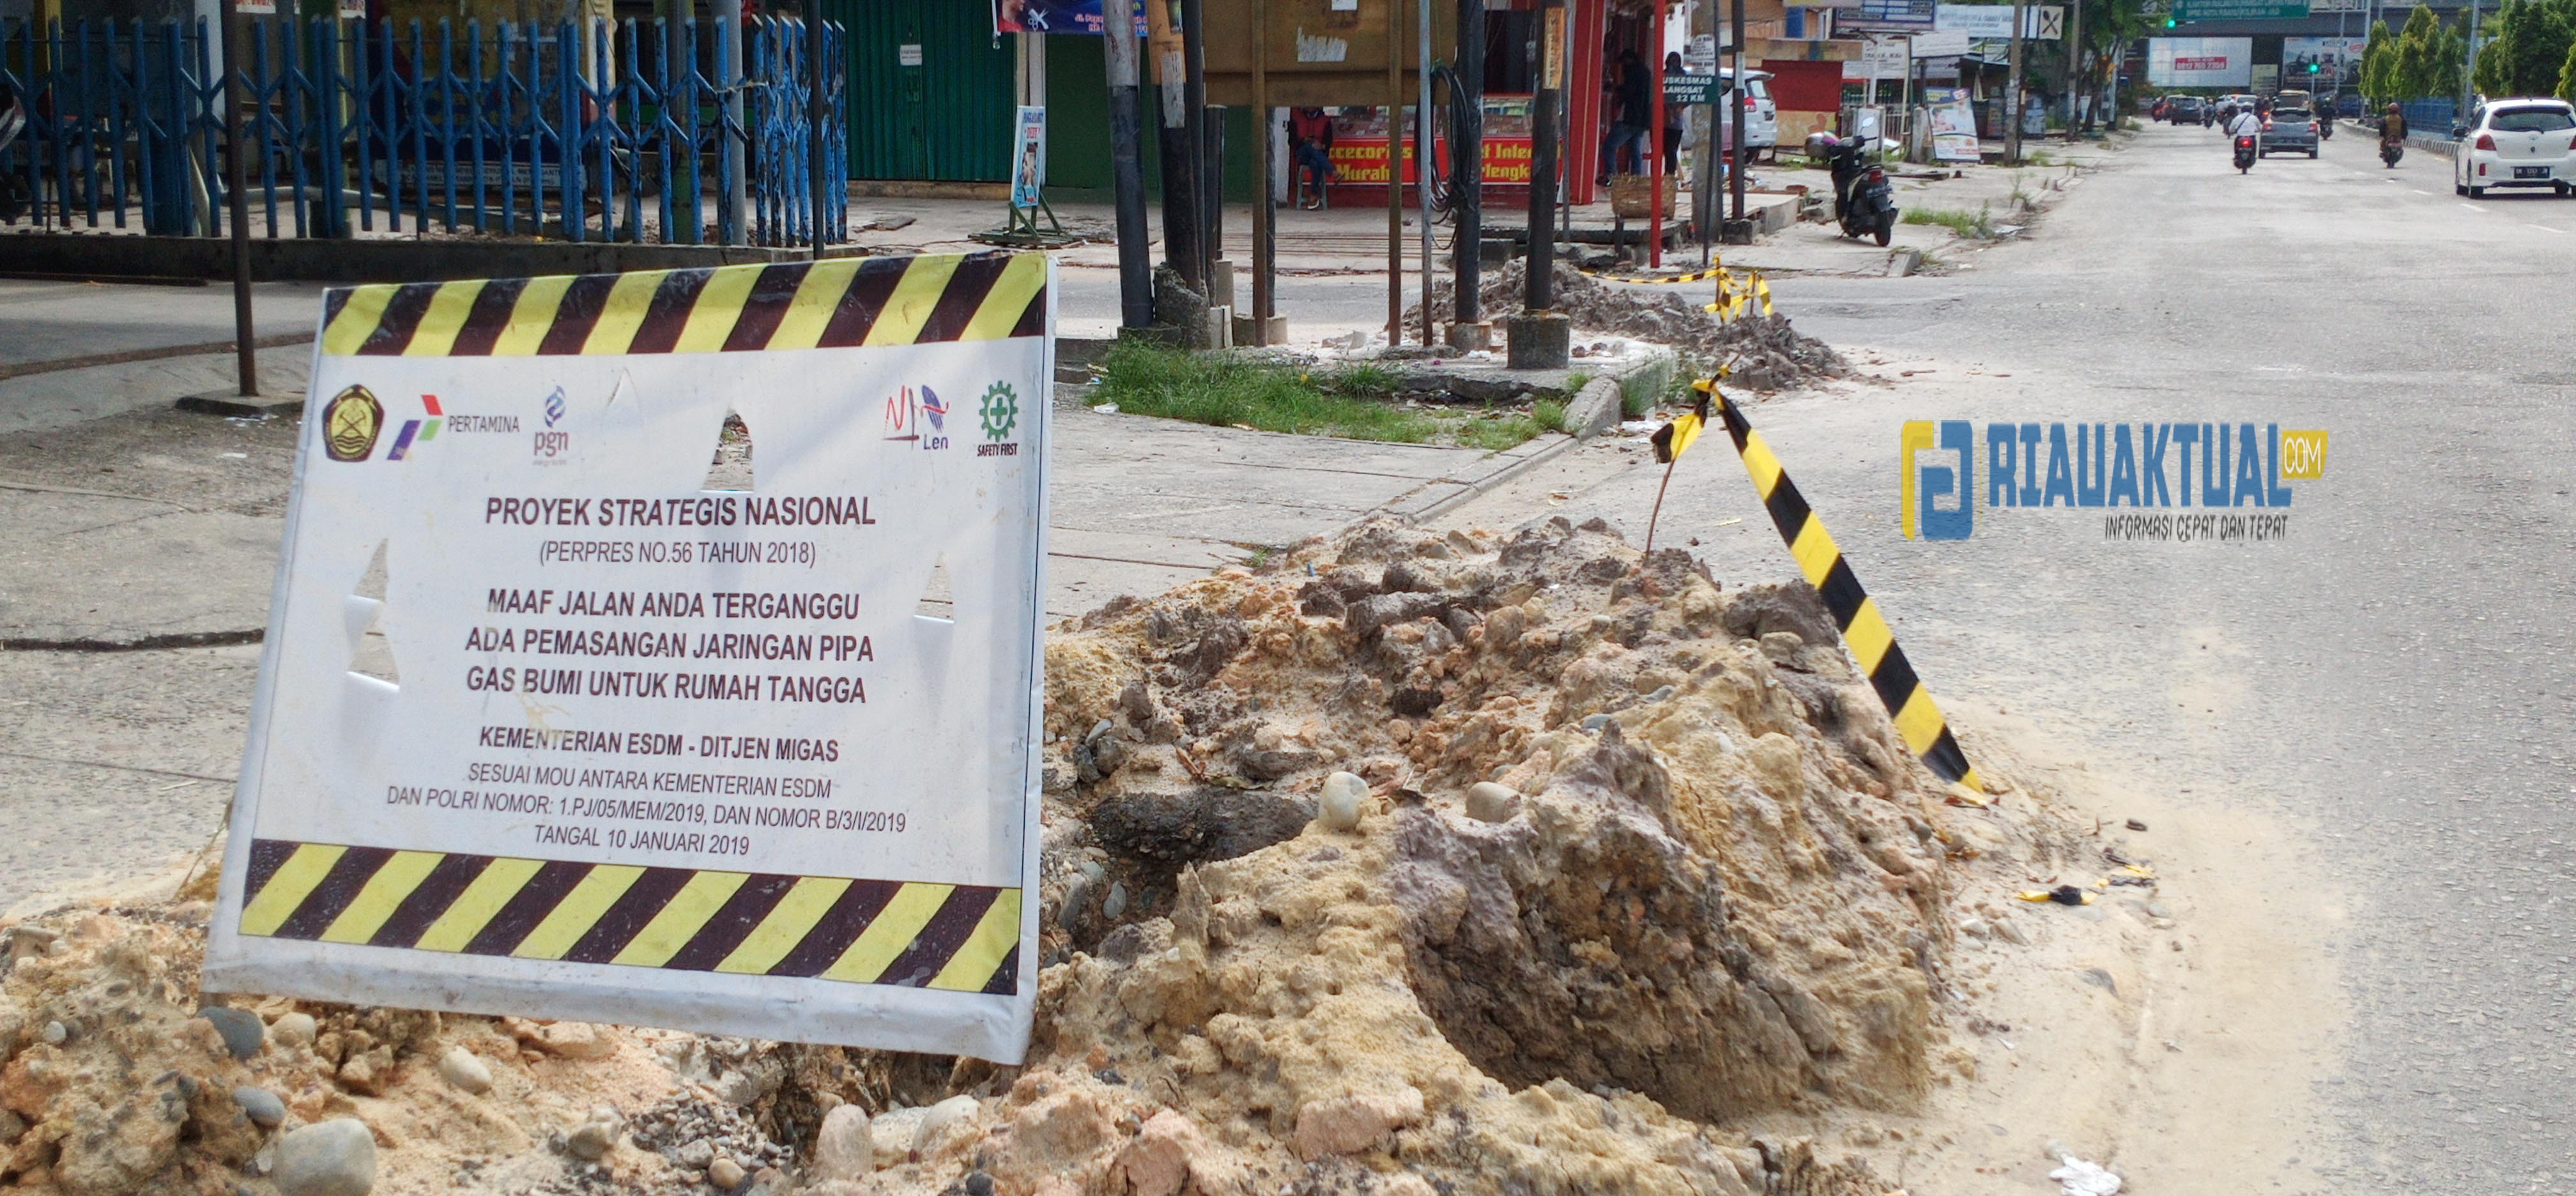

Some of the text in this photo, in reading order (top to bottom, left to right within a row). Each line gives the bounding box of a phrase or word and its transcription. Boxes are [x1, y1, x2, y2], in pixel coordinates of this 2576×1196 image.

[1328, 143, 1413, 159] ccecoris
[448, 415, 519, 433] PERTAMINA
[534, 432, 568, 457] pgn
[924, 434, 948, 450] Len
[977, 443, 1018, 456] SAFETY FIRST
[486, 496, 875, 526] PROYEK STRATEGIS NASIONAL
[540, 540, 815, 569] (PERPRES NO.56 TAHUN 2018)
[489, 588, 859, 619] MAAF JALAN ANDA TERGANGGU
[465, 627, 873, 661] ADA PEMASANGAN JARINGAN PIPA
[467, 666, 866, 703] GAS BUMI UNTUK RUMAH TANGGA
[480, 726, 622, 753] KEMENTERIAN
[627, 733, 682, 755] ESDM
[701, 736, 770, 759] DITJEN
[776, 739, 838, 762] MIGAS
[468, 763, 831, 798] SESUAI MOU ANTARA KEMENTERIAN ESDM
[387, 786, 905, 832] DAN POLRI NOMOR: 1.PJ/05/MEM/2019, DAN NOMOR B/3/I/2019
[535, 825, 749, 855] TANGAL 10 JANUARI 2019
